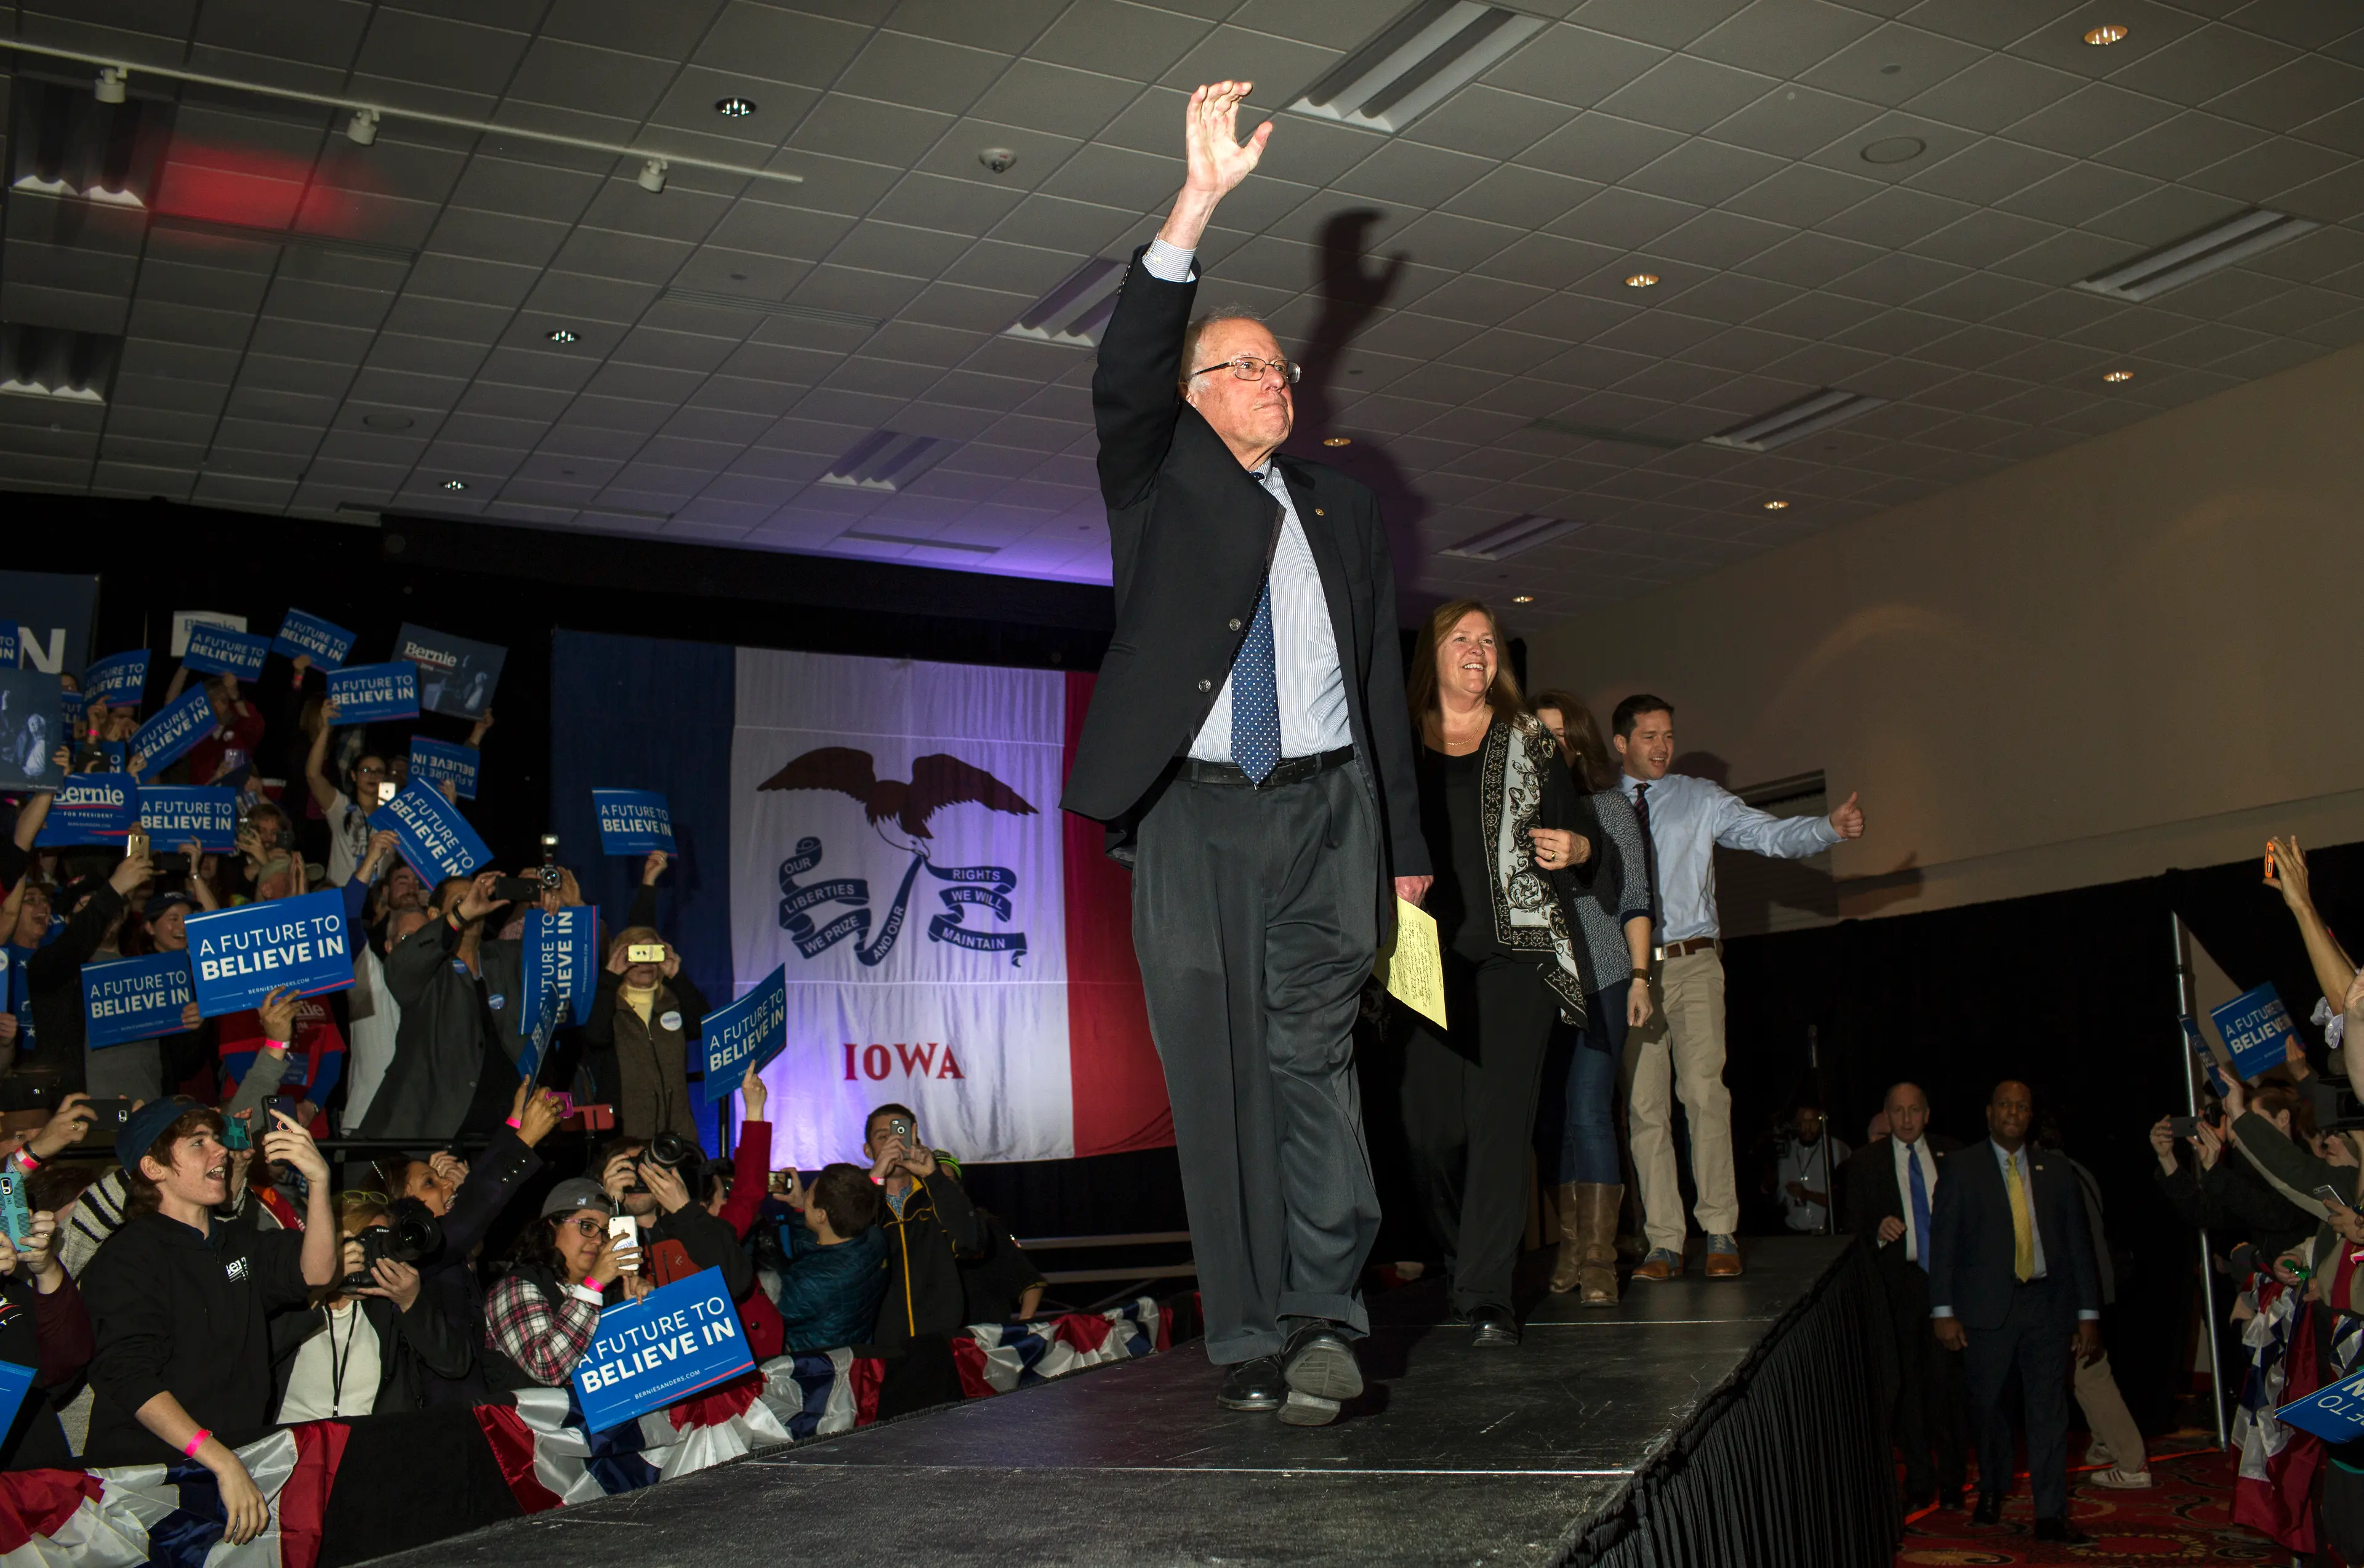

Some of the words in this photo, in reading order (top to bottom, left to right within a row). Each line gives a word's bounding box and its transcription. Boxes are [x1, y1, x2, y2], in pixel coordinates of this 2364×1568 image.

[193, 633, 202, 642] A
[204, 635, 249, 654] FUTURE
[251, 646, 265, 657] TO
[280, 627, 328, 655] BELIEVE
[327, 647, 344, 662] IN
[286, 619, 292, 628] A
[293, 621, 332, 645] FUTURE
[333, 637, 347, 652] TO
[190, 642, 246, 665] BELIEVE
[247, 656, 262, 668] IN
[403, 641, 458, 667] Bernie
[126, 674, 143, 688] IN
[128, 662, 145, 675] TO
[331, 681, 340, 692] A
[342, 676, 392, 691] FUTURE
[394, 675, 413, 686] TO
[331, 688, 394, 706] BELIEVE
[397, 686, 414, 700] IN
[142, 708, 186, 746] FUTURE
[187, 696, 205, 712] TO
[193, 704, 210, 724] IN
[411, 765, 425, 776] TO
[412, 752, 427, 765] IN
[430, 755, 476, 778] BELIEVE
[140, 800, 151, 813] A
[155, 801, 211, 814] FUTURE
[214, 802, 232, 815] TO
[601, 804, 609, 816] A
[610, 804, 656, 818] FUTURE
[655, 808, 669, 821] TO
[140, 814, 212, 830] BELIEVE
[215, 817, 231, 830] IN
[402, 791, 416, 802] A
[412, 798, 459, 850] FUTURE
[456, 846, 475, 869] TO
[601, 818, 660, 834] BELIEVE
[659, 822, 672, 837] IN
[388, 798, 448, 859] BELIEVE
[441, 857, 463, 877] IN
[784, 856, 812, 875] OUR
[952, 868, 1001, 882] RIGHTS
[784, 883, 855, 914] LIBERTIES
[951, 890, 971, 902] WE
[975, 890, 1003, 911] WILL
[200, 938, 215, 957] A
[220, 920, 307, 953] FUTURE
[311, 914, 340, 935] TO
[542, 912, 555, 938] TO
[557, 911, 573, 934] IN
[803, 936, 826, 954] WE
[826, 915, 860, 943] PRIZE
[872, 935, 893, 960] AND
[887, 904, 904, 935] OUR
[941, 927, 1006, 949] MAINTAIN
[201, 942, 312, 981] BELIEVE
[317, 935, 344, 959] IN
[90, 984, 101, 999] A
[104, 974, 164, 997] FUTURE
[166, 970, 187, 986] TO
[90, 991, 167, 1019] BELIEVE
[171, 987, 190, 1005] IN
[710, 1035, 720, 1051] A
[723, 1000, 768, 1044] FUTURE
[770, 987, 784, 1005] TO
[2225, 1024, 2236, 1037] A
[709, 1018, 769, 1073] BELIEVE
[771, 1005, 784, 1029] IN
[843, 1043, 965, 1081] IOWA
[577, 1354, 593, 1369] A
[595, 1309, 690, 1361] FUTURE
[690, 1297, 725, 1321] TO
[581, 1331, 699, 1394] BELIEVE
[702, 1317, 735, 1346] IN
[634, 1369, 701, 1400] BERNIESANDERS.COM
[2317, 1395, 2355, 1415] TO
